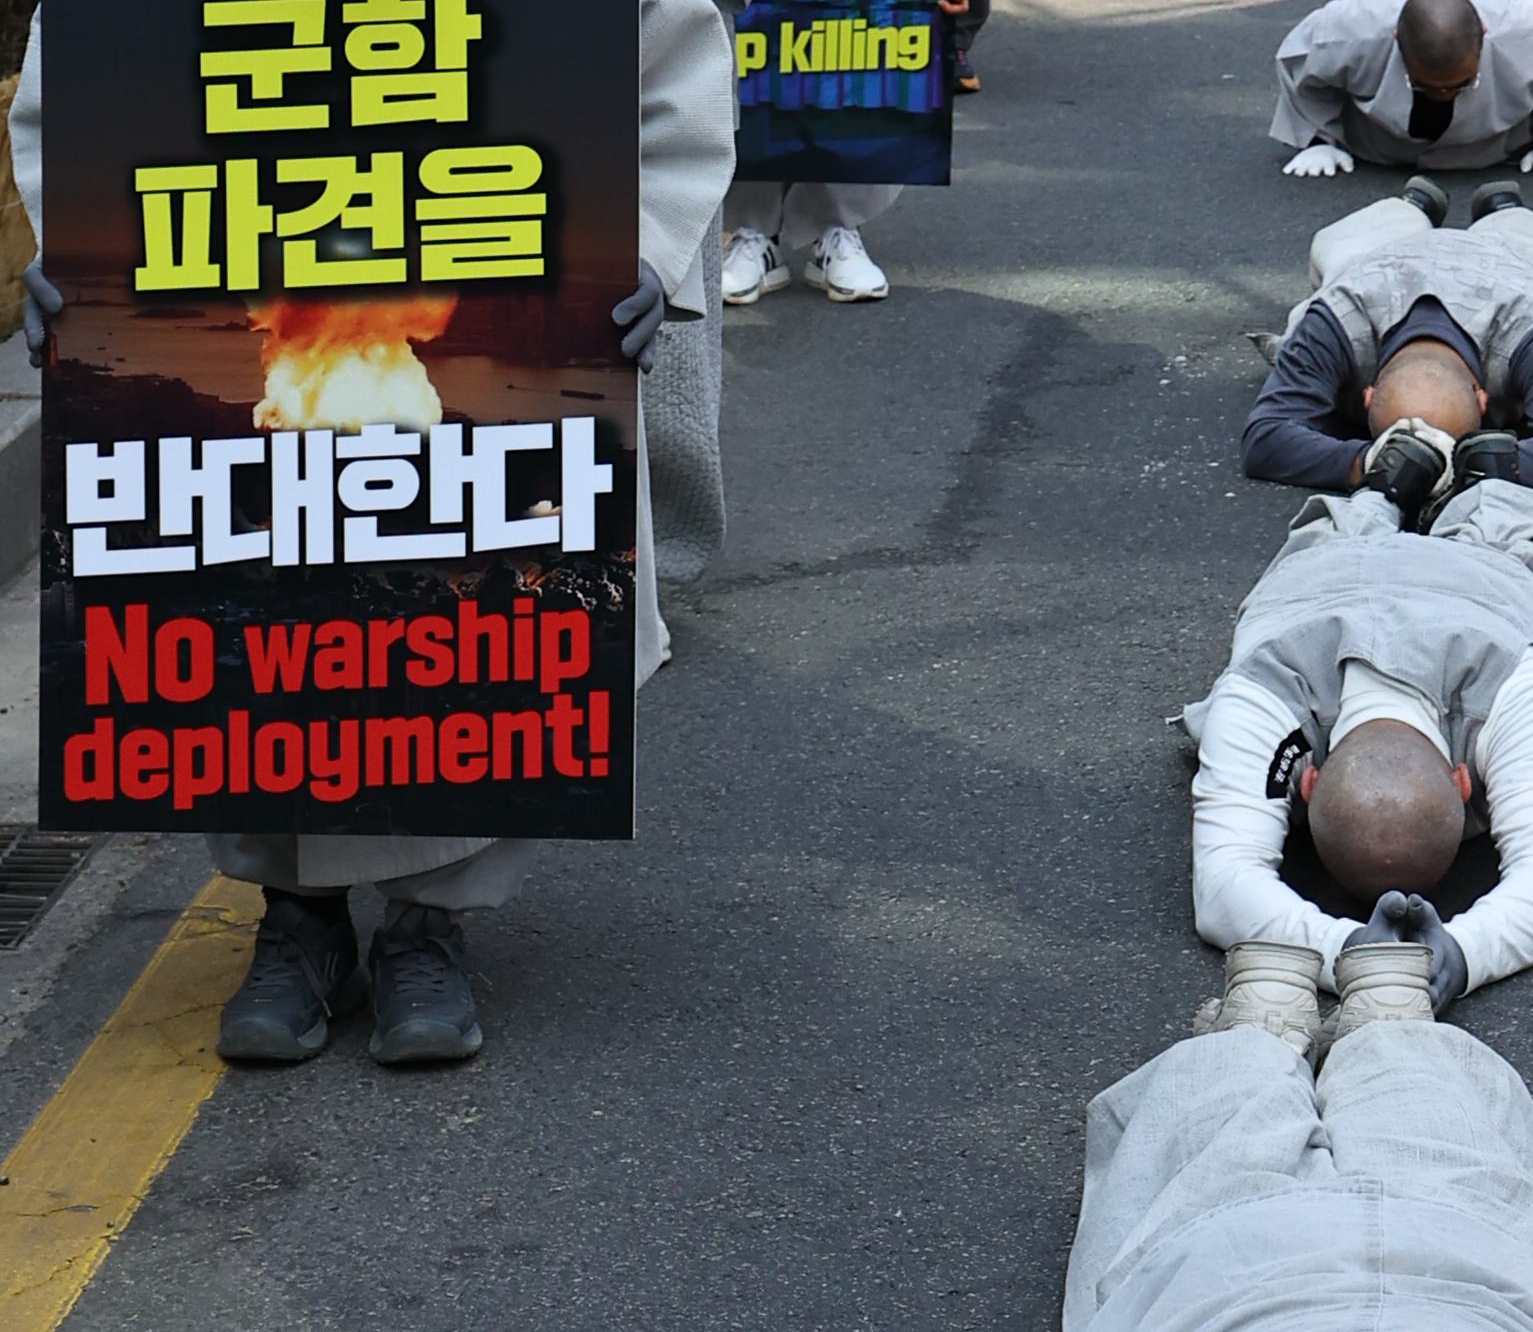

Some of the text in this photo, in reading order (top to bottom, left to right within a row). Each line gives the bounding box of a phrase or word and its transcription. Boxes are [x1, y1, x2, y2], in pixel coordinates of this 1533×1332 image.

[780, 18, 932, 74] killing
[134, 144, 547, 293] 파견을
[66, 416, 613, 578] 반대한다
[85, 598, 590, 705] No warship
[63, 691, 610, 811] deployment!
